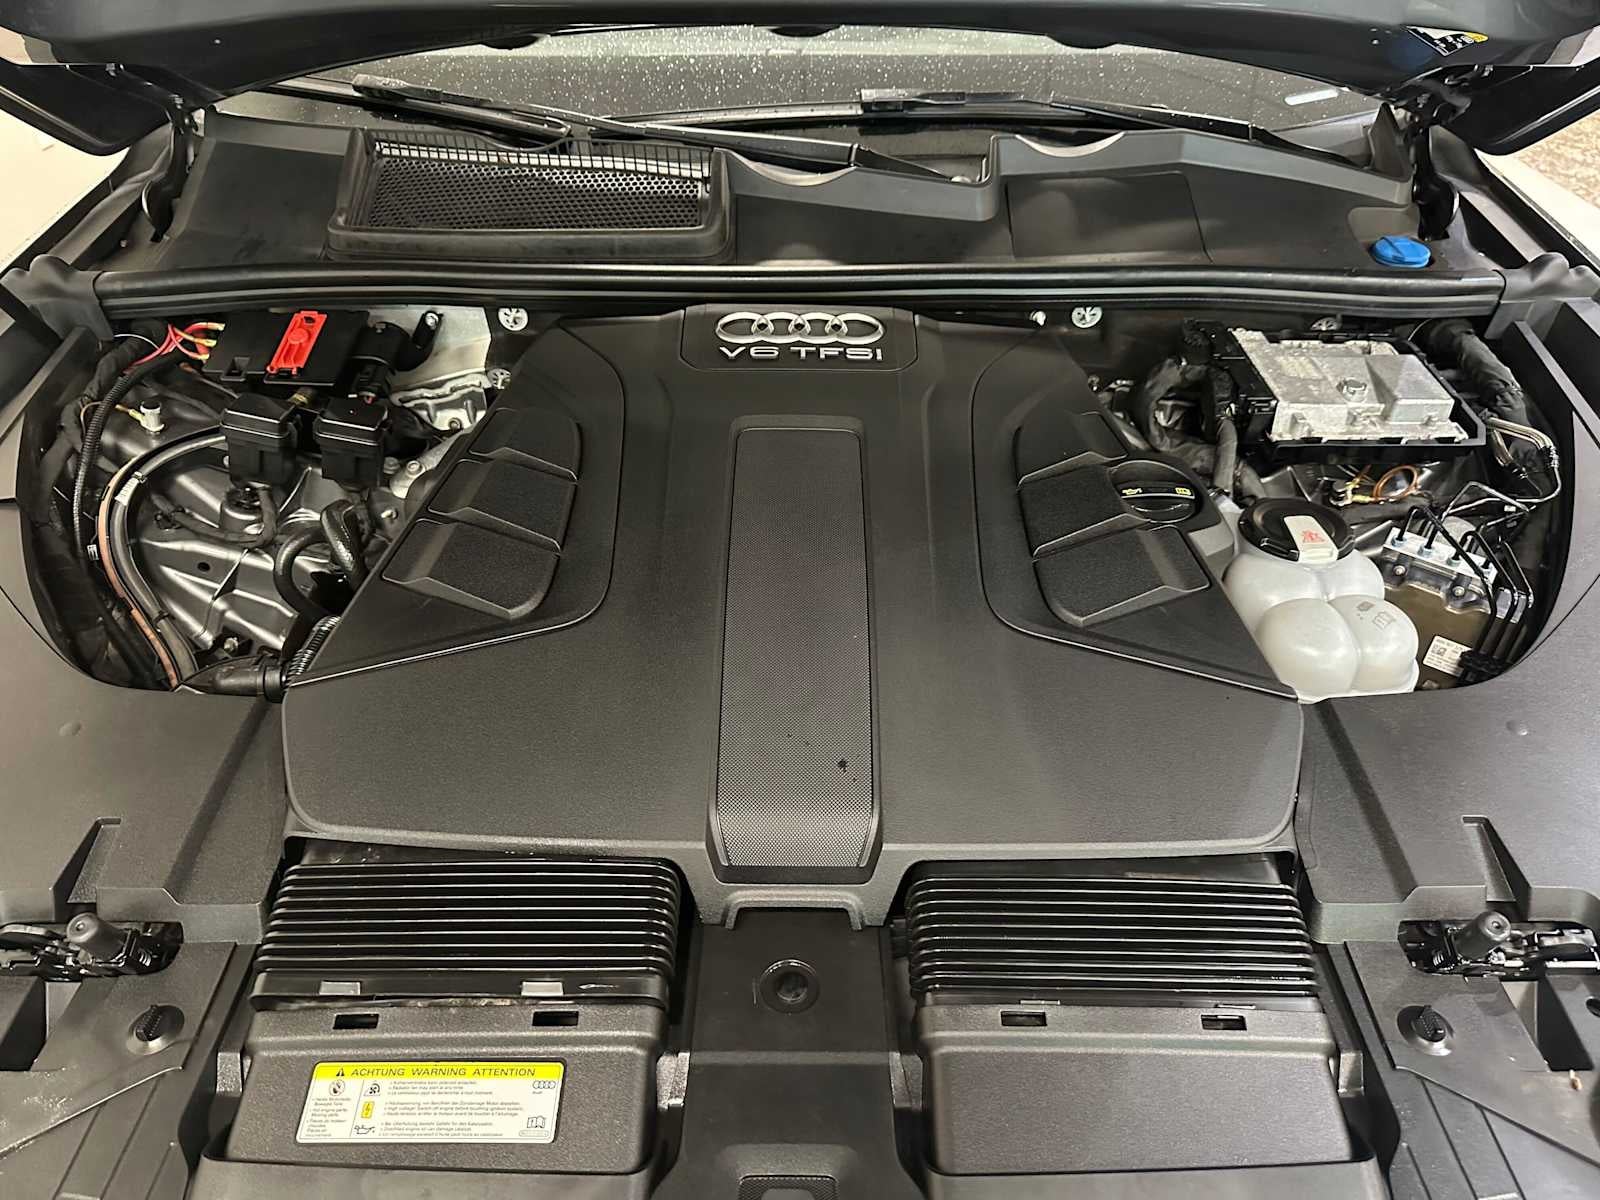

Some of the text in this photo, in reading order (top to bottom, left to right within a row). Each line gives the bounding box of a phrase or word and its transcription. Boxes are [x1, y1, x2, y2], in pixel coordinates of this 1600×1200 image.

[719, 346, 883, 361] V6 TFSI
[351, 1067, 536, 1077] ACHTUNG WARNING ATTENTION
